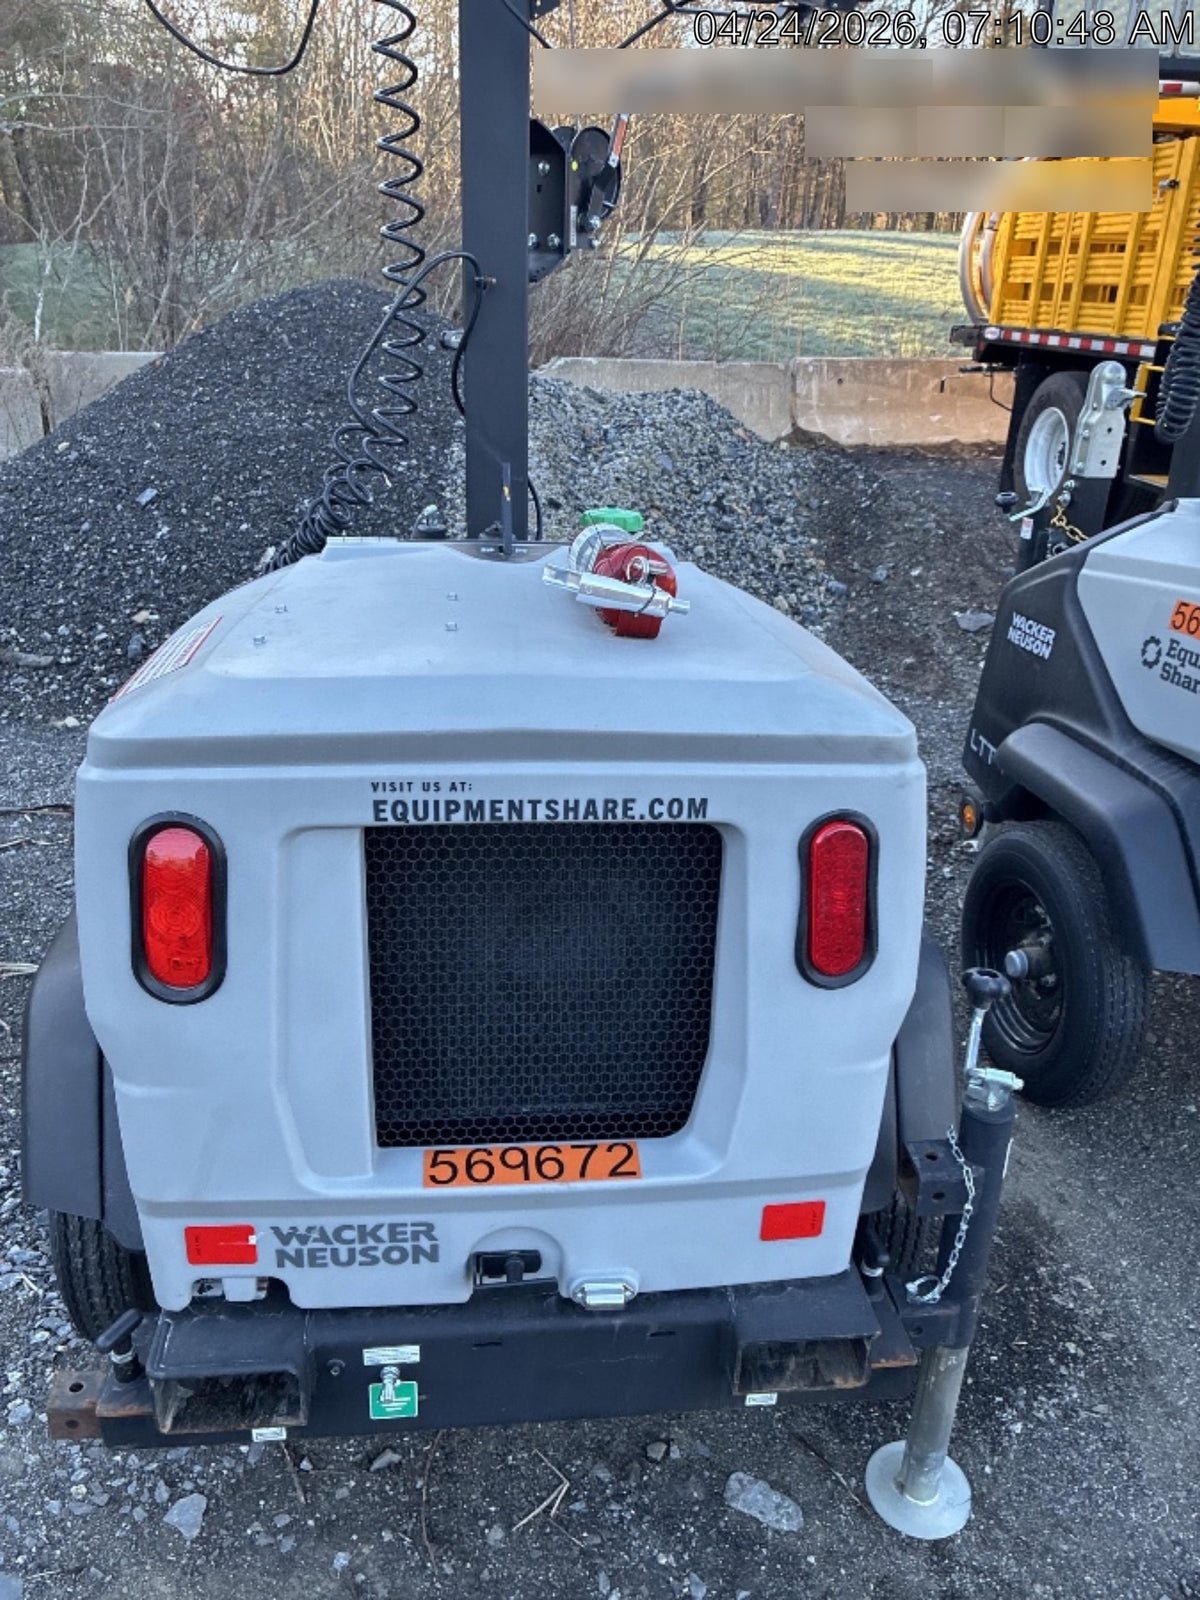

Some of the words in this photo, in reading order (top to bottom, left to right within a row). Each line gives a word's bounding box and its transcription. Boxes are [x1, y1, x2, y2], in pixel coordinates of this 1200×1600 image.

[1007, 626, 1053, 660] NEUSON
[1011, 611, 1056, 645] WACKER
[1165, 637, 1200, 669] Equ
[970, 728, 997, 765] LTT
[371, 782, 414, 793] VISIT
[422, 782, 441, 792] US
[449, 781, 473, 792] AT:
[372, 798, 709, 824] EQUIPMENTSHARE.COM
[428, 1142, 638, 1185] 569672
[269, 1222, 439, 1246] WACKER
[274, 1243, 440, 1269] NEUSON
